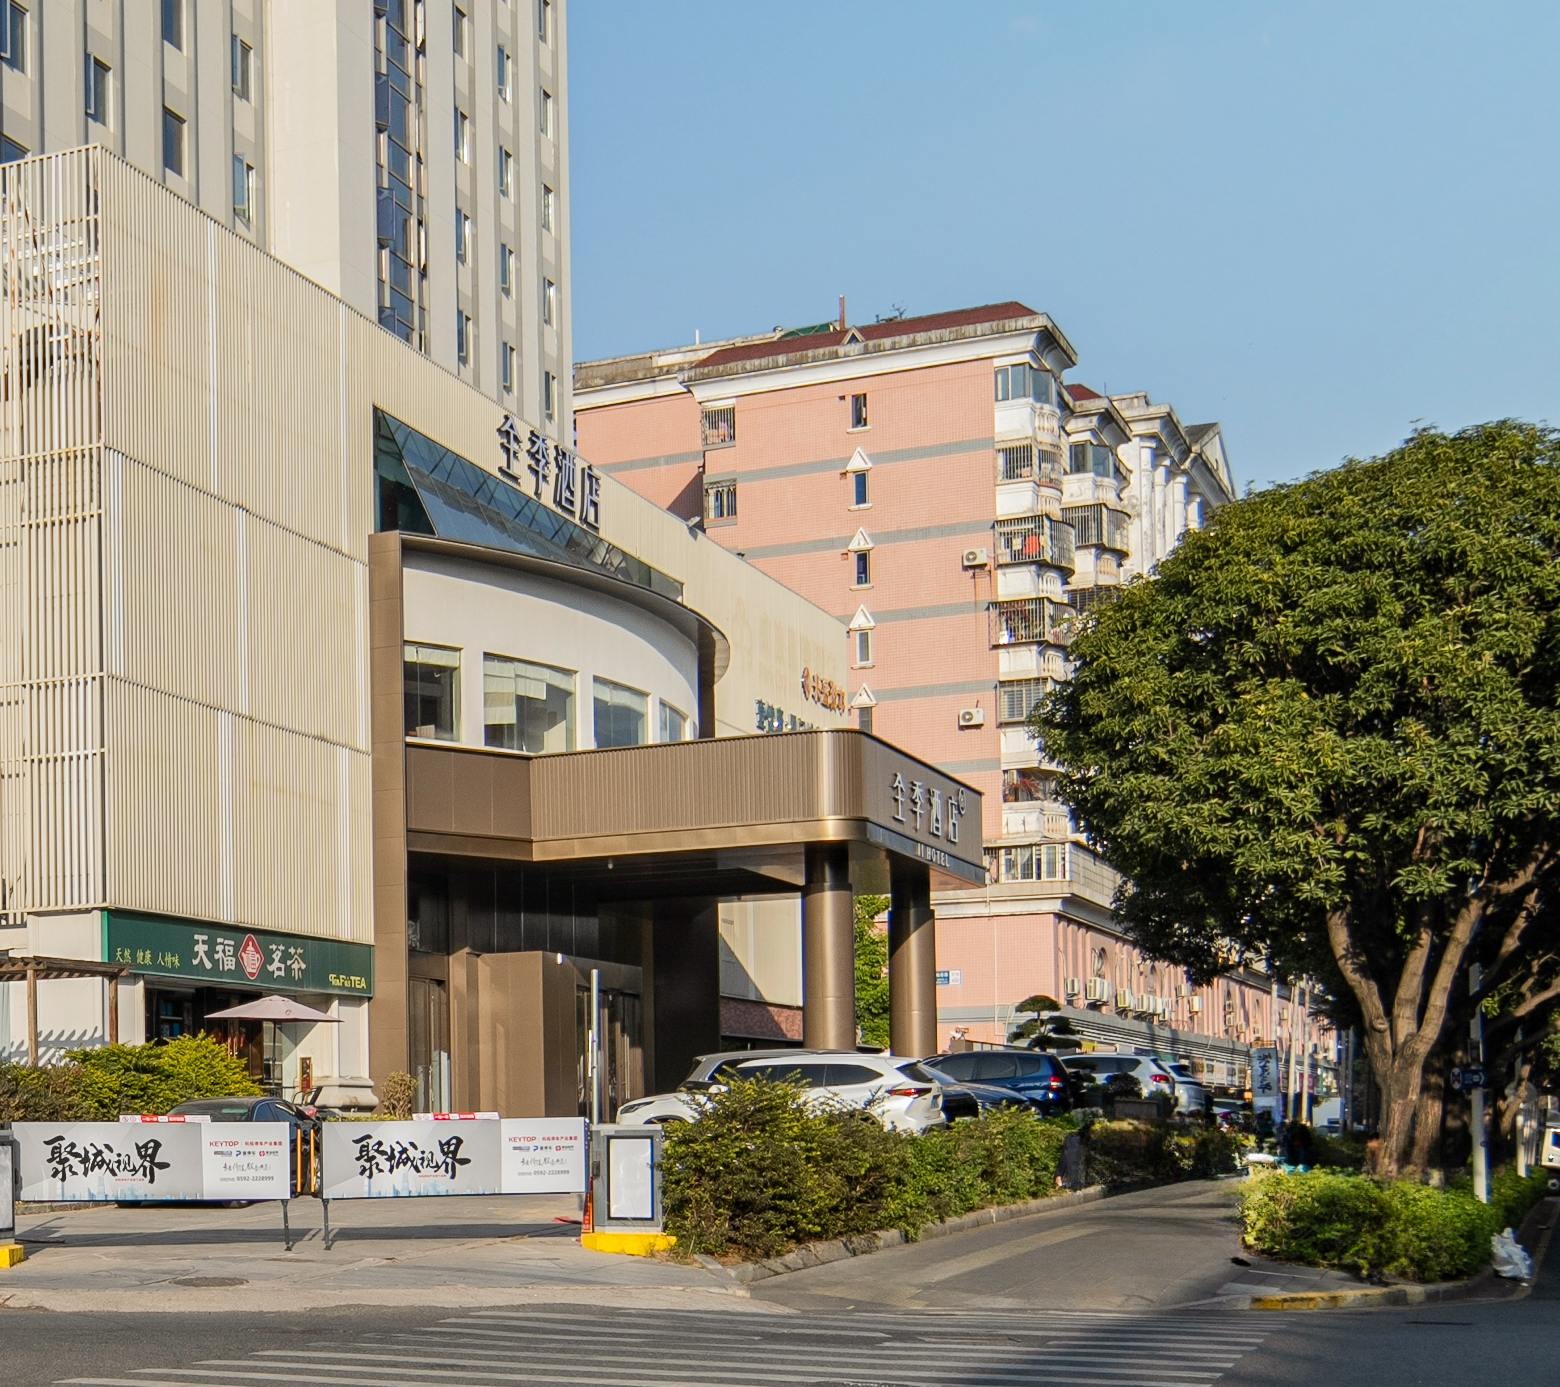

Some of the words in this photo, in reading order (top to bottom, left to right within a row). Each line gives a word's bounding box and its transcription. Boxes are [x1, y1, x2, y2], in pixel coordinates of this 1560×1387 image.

[497, 414, 602, 535] 全季酒店
[892, 771, 959, 843] 全季酒店
[926, 846, 950, 868] HOTEL
[115, 947, 132, 964] 天然
[136, 948, 153, 966] 健康
[156, 951, 181, 969] 人情味
[350, 975, 367, 990] TEA
[508, 1135, 537, 1143] KEYTOP
[42, 1134, 171, 1185] 聚城视界
[352, 1133, 472, 1180] 聚城视界
